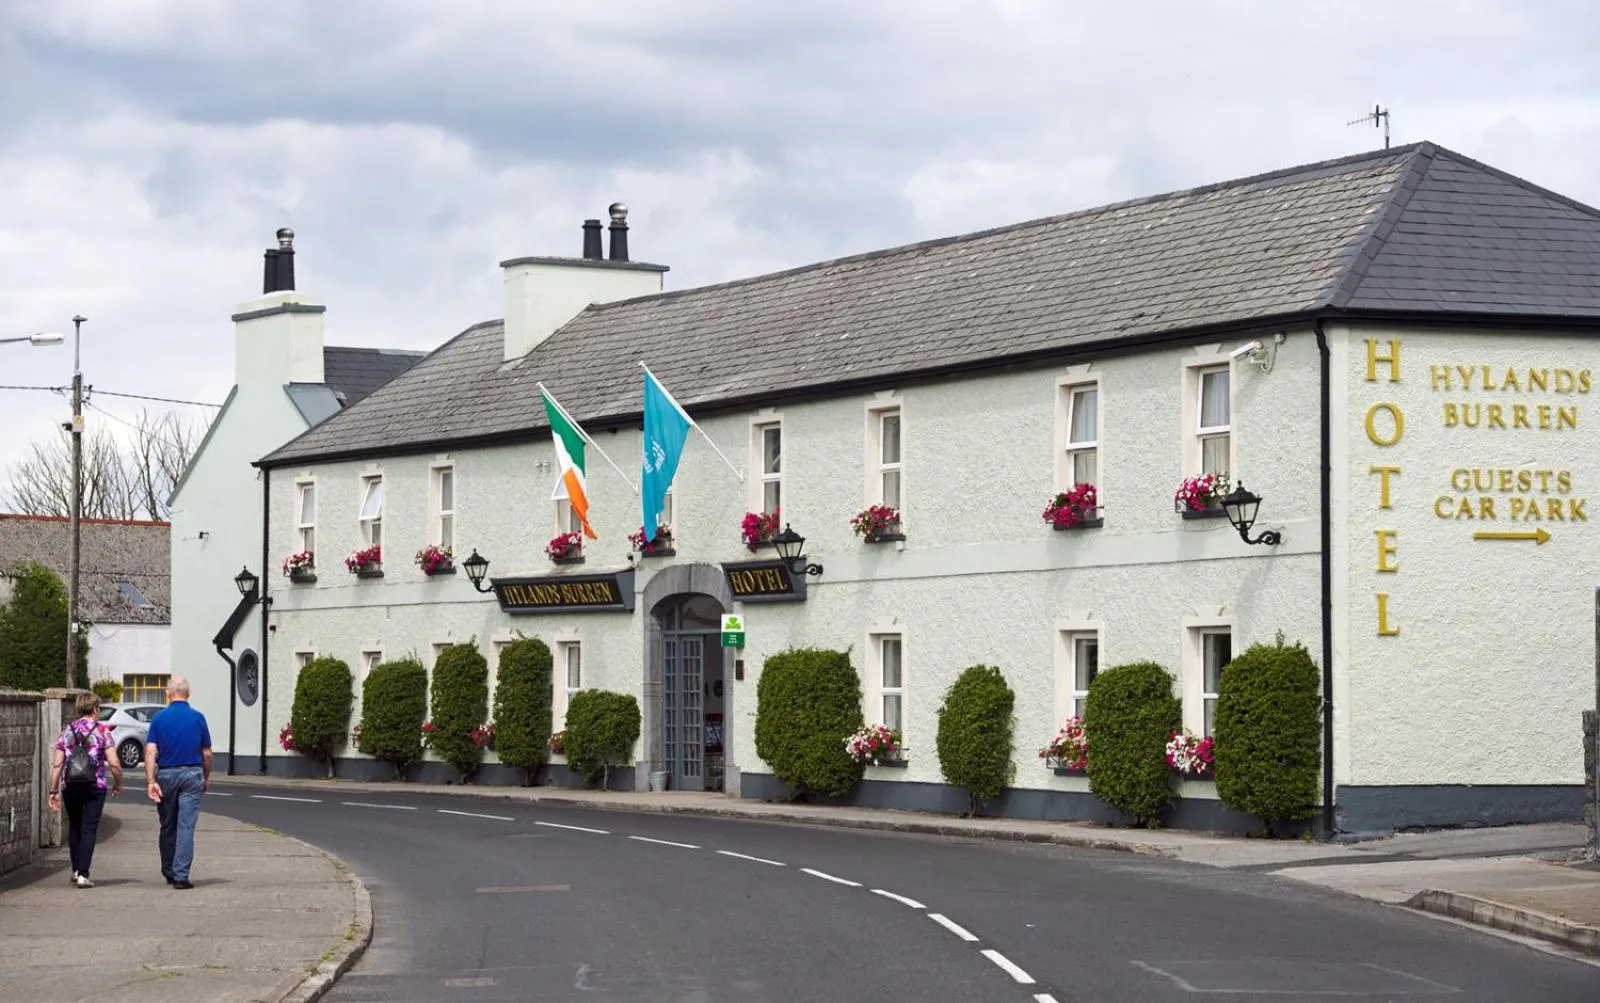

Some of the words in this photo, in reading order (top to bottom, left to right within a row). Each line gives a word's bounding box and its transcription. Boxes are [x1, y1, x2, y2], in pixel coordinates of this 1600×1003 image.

[1430, 364, 1592, 394] HYLANDS
[1443, 402, 1578, 430] BURREN
[1363, 337, 1405, 636] HOTEL
[1451, 468, 1573, 493] GUESTS
[1434, 496, 1497, 520] CAR
[1510, 497, 1588, 522] PARK
[503, 584, 561, 605] HYLANDS
[560, 581, 613, 604] BURREN
[729, 568, 788, 593] HOTEL
